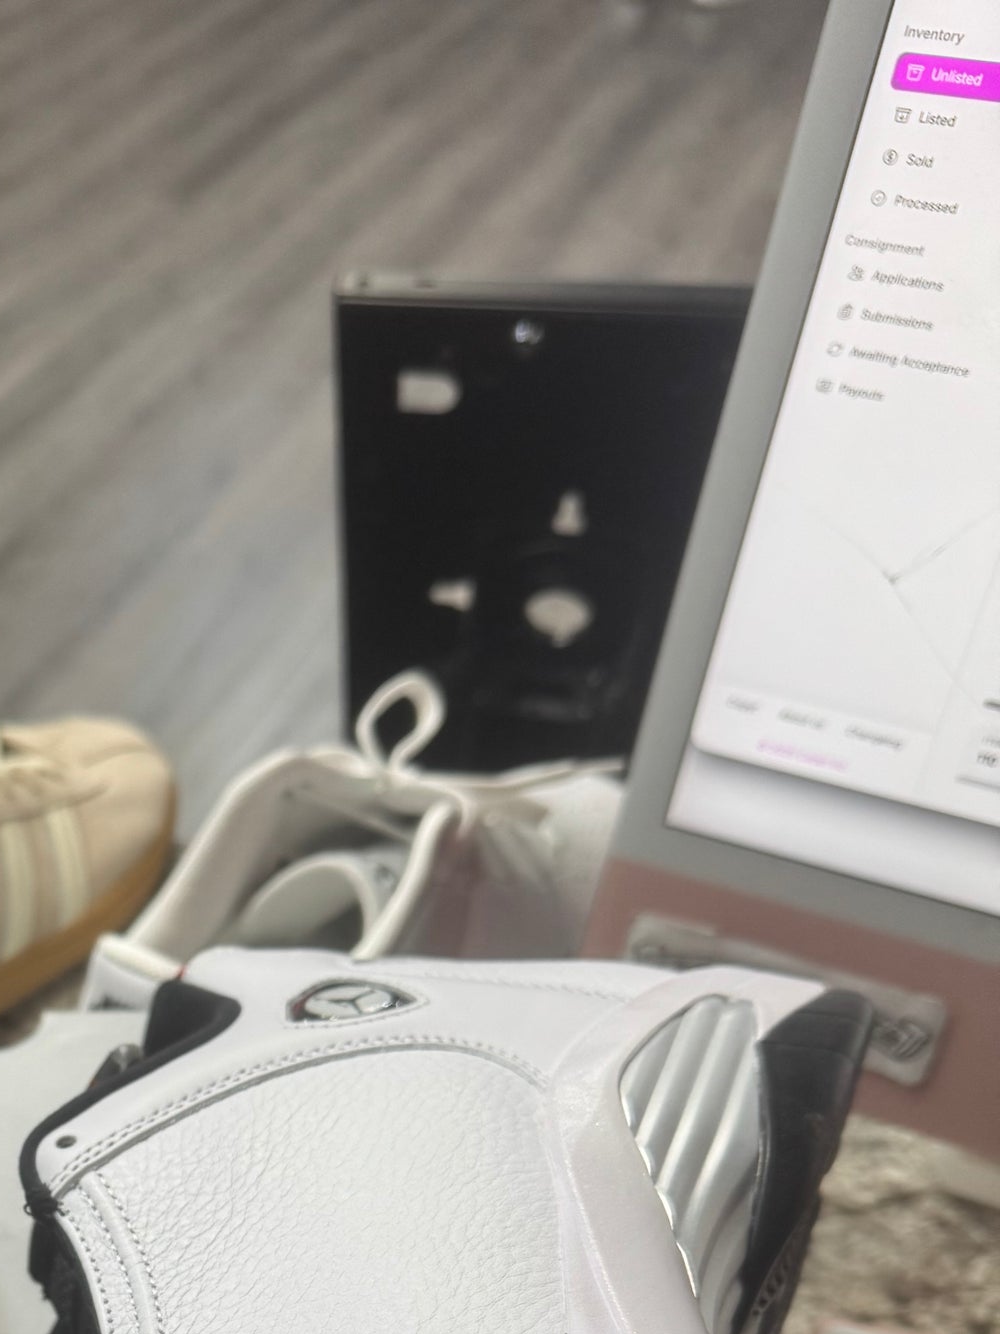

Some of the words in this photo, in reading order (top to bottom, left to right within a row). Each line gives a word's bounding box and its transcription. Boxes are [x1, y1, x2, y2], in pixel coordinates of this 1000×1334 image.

[903, 25, 965, 46] Inventory
[931, 66, 984, 87] Unlisted
[918, 111, 957, 128] Listed
[906, 153, 935, 168] Sold
[894, 194, 959, 215] Processed
[844, 234, 926, 257] Consignment
[871, 270, 945, 293] Applications
[860, 308, 934, 331] Submissions
[849, 346, 898, 368] Awaiting
